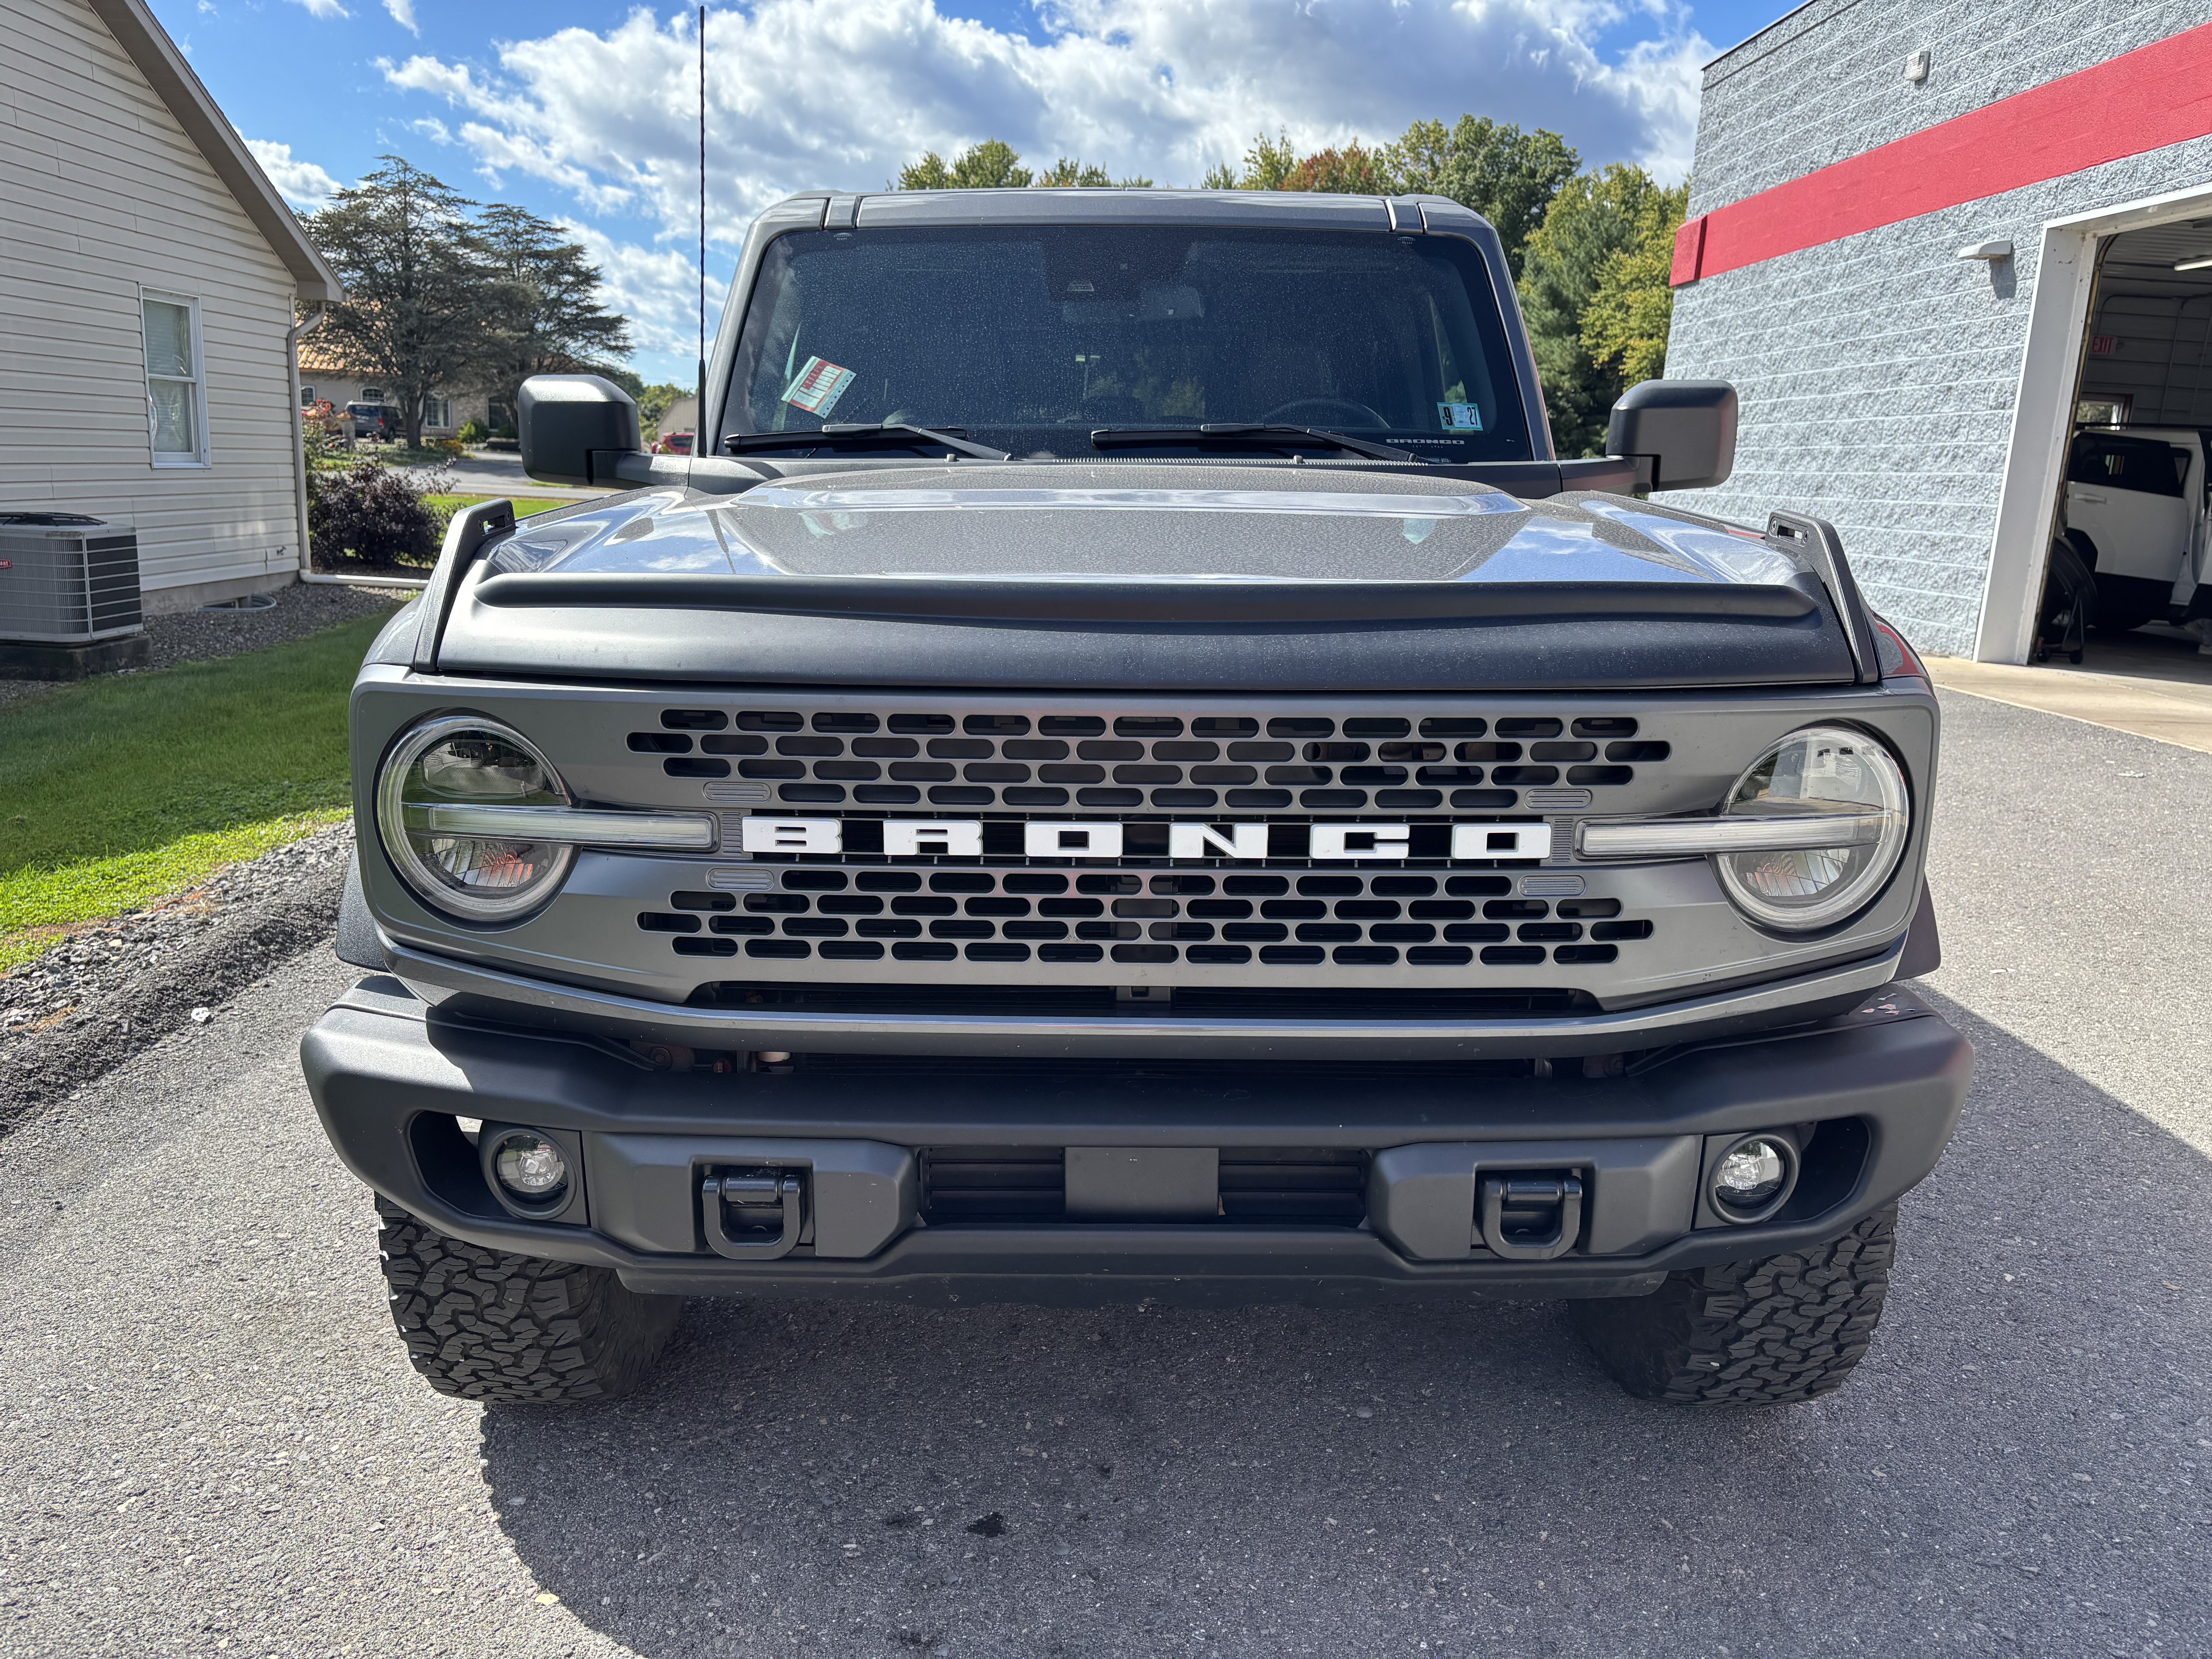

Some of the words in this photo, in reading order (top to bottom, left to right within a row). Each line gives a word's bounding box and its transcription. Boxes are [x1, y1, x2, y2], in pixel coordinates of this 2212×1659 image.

[2092, 336, 2114, 353] EXIT
[1443, 407, 1453, 426] 9
[1467, 407, 1478, 426] 27
[742, 816, 1551, 859] BRONCO
